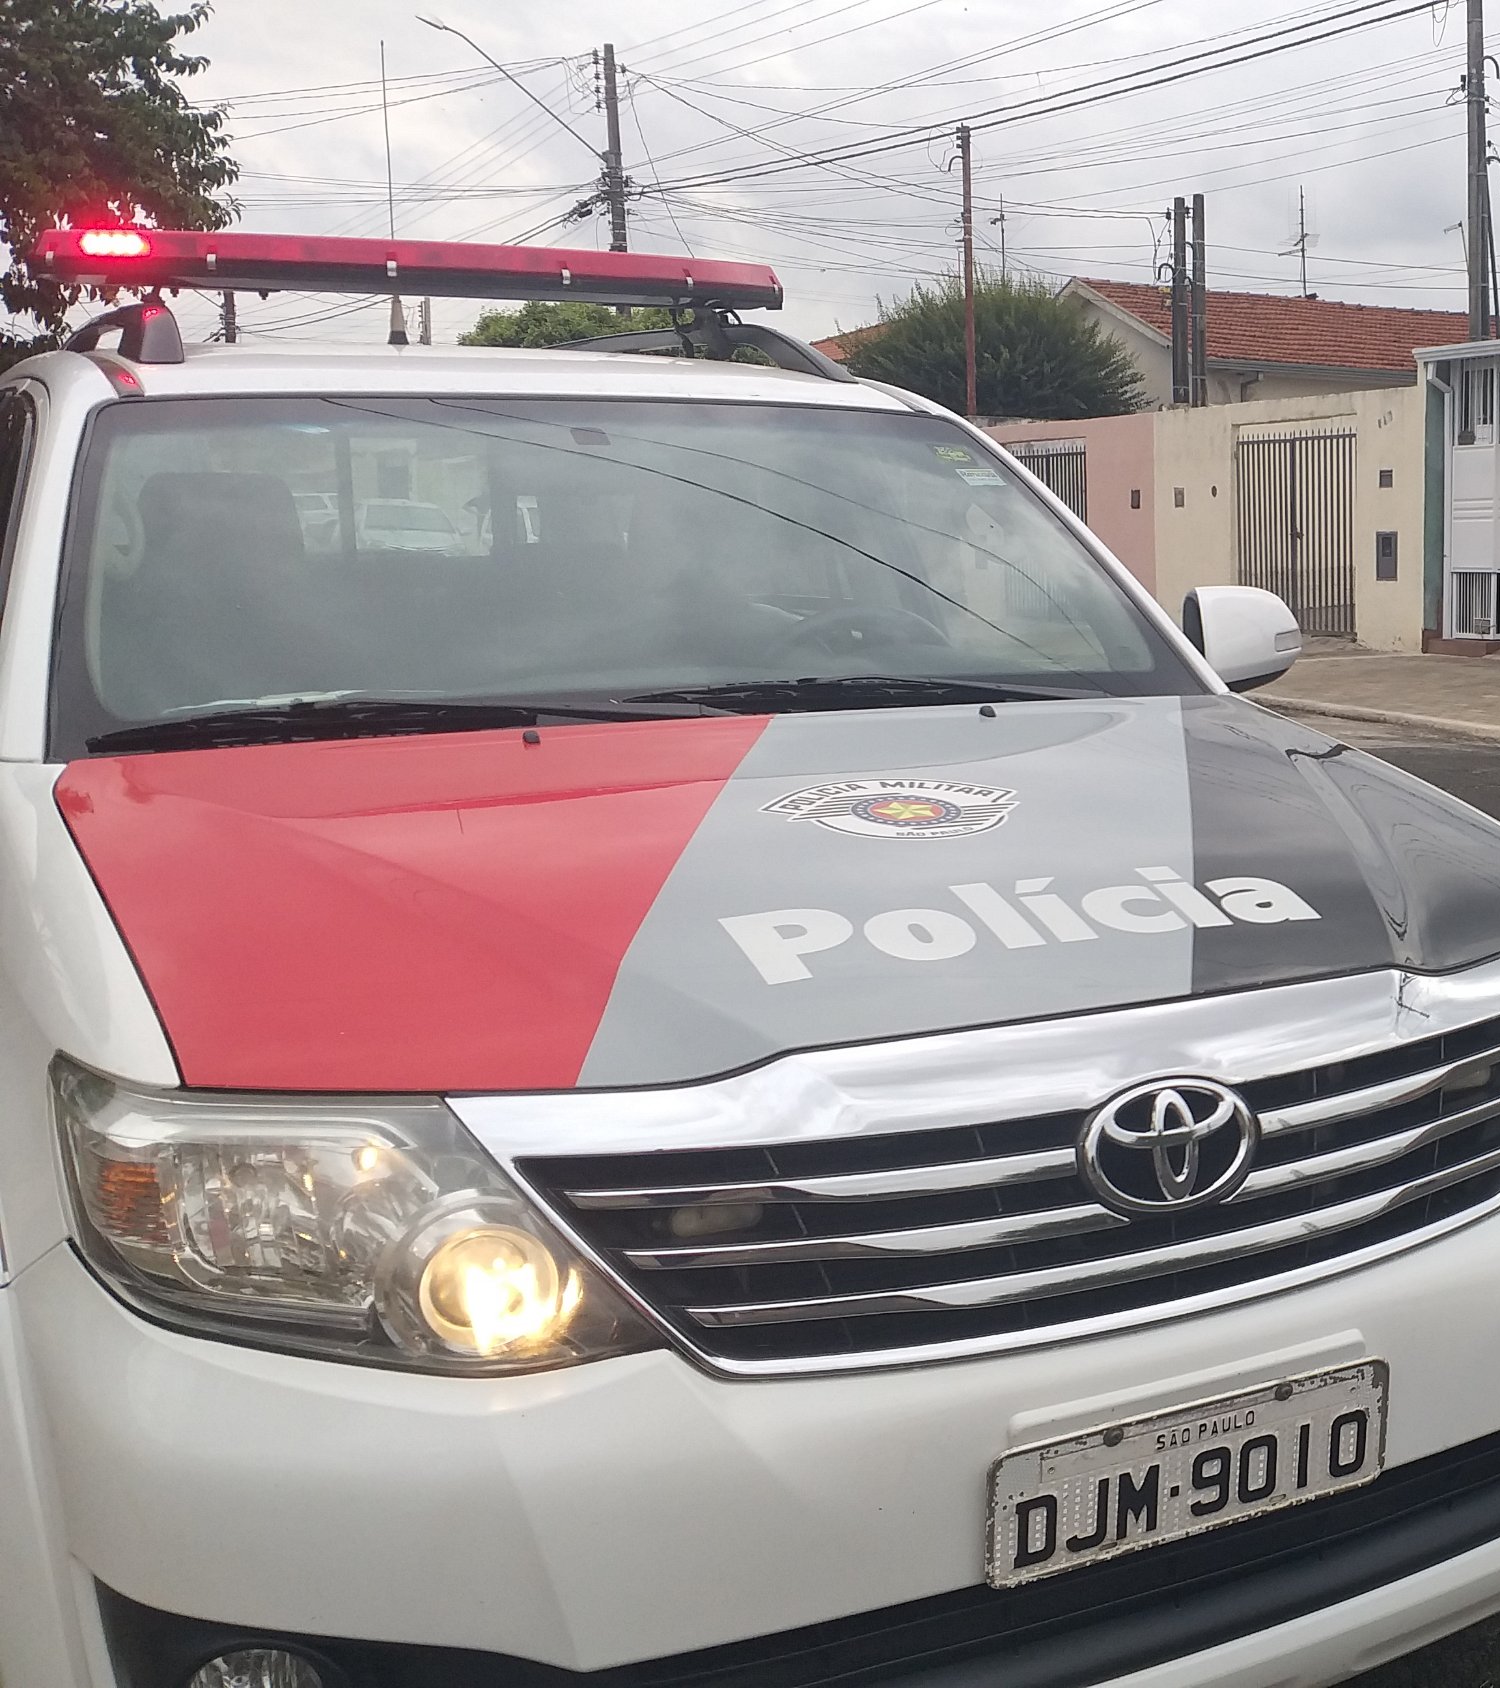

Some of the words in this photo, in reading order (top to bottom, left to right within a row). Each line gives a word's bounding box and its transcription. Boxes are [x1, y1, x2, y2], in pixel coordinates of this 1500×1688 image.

[879, 781, 994, 798] MILITAR
[717, 866, 1323, 986] Polícia
[1156, 1428, 1191, 1450] SÃO
[1198, 1410, 1255, 1440] PAULO
